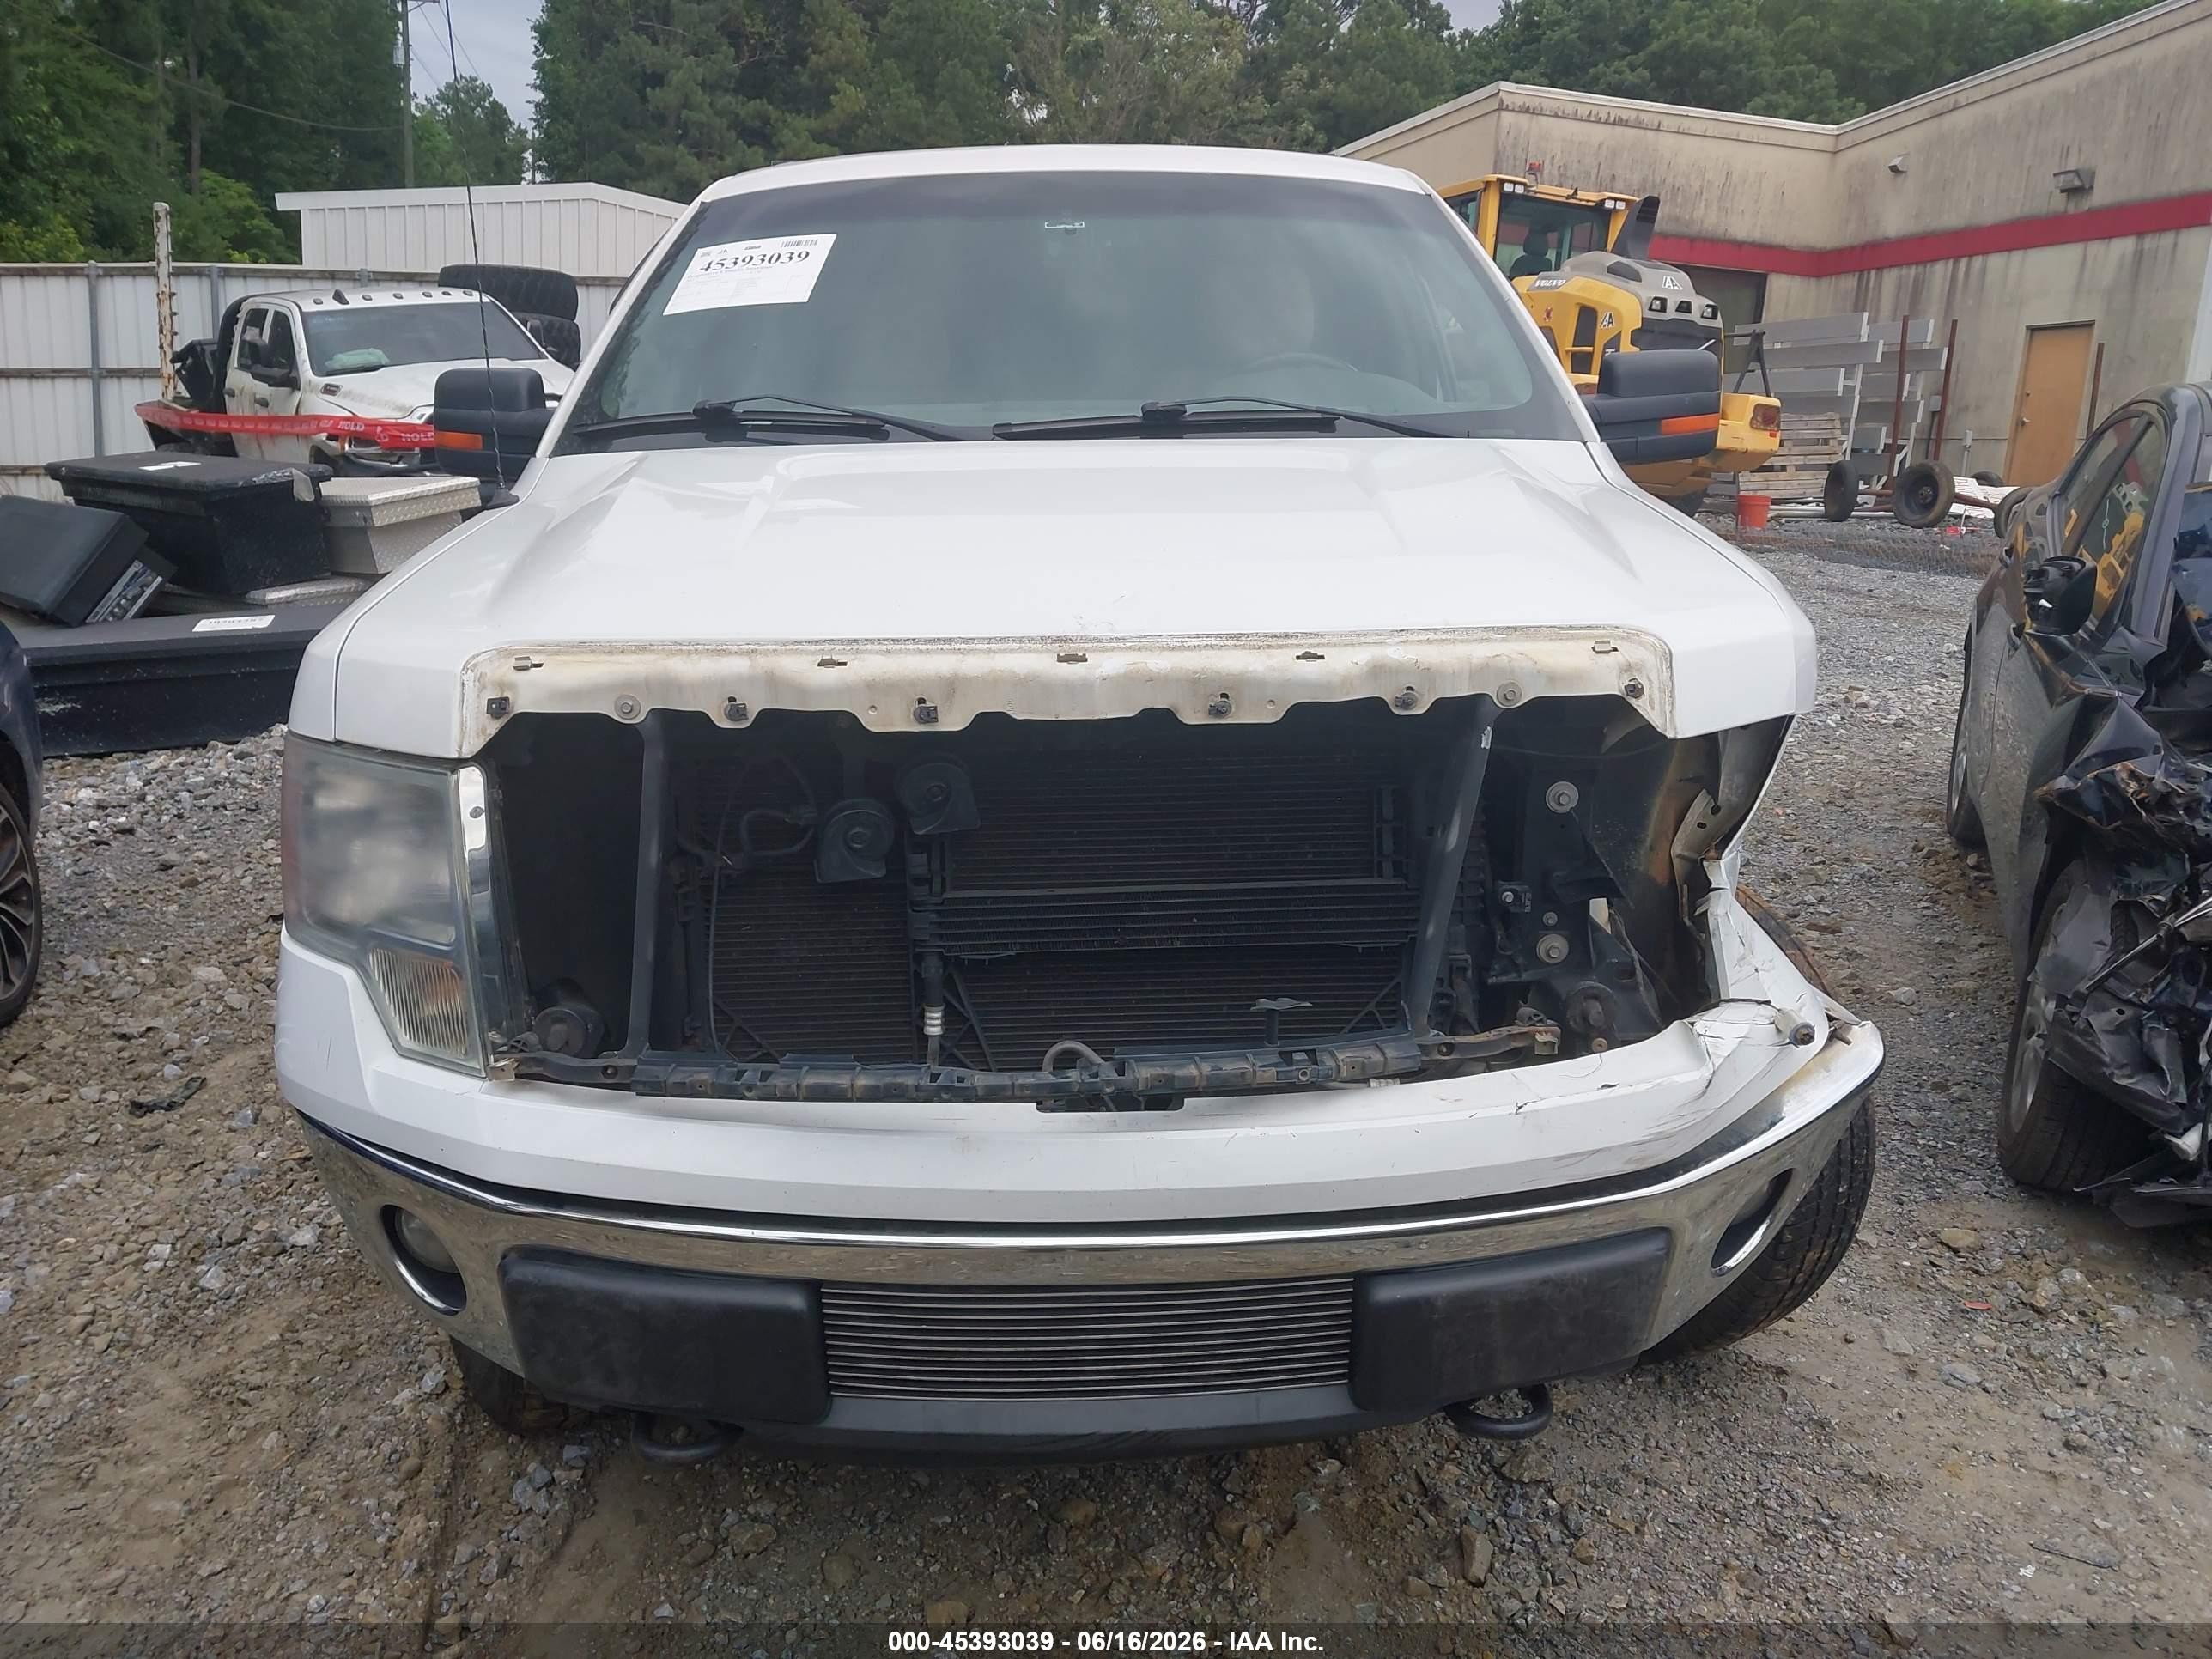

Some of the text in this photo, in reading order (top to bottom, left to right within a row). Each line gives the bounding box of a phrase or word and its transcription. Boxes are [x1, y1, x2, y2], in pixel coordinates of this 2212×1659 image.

[699, 250, 810, 272] 45393039
[1535, 279, 1566, 288] VOLVO
[337, 421, 364, 432] HOLD
